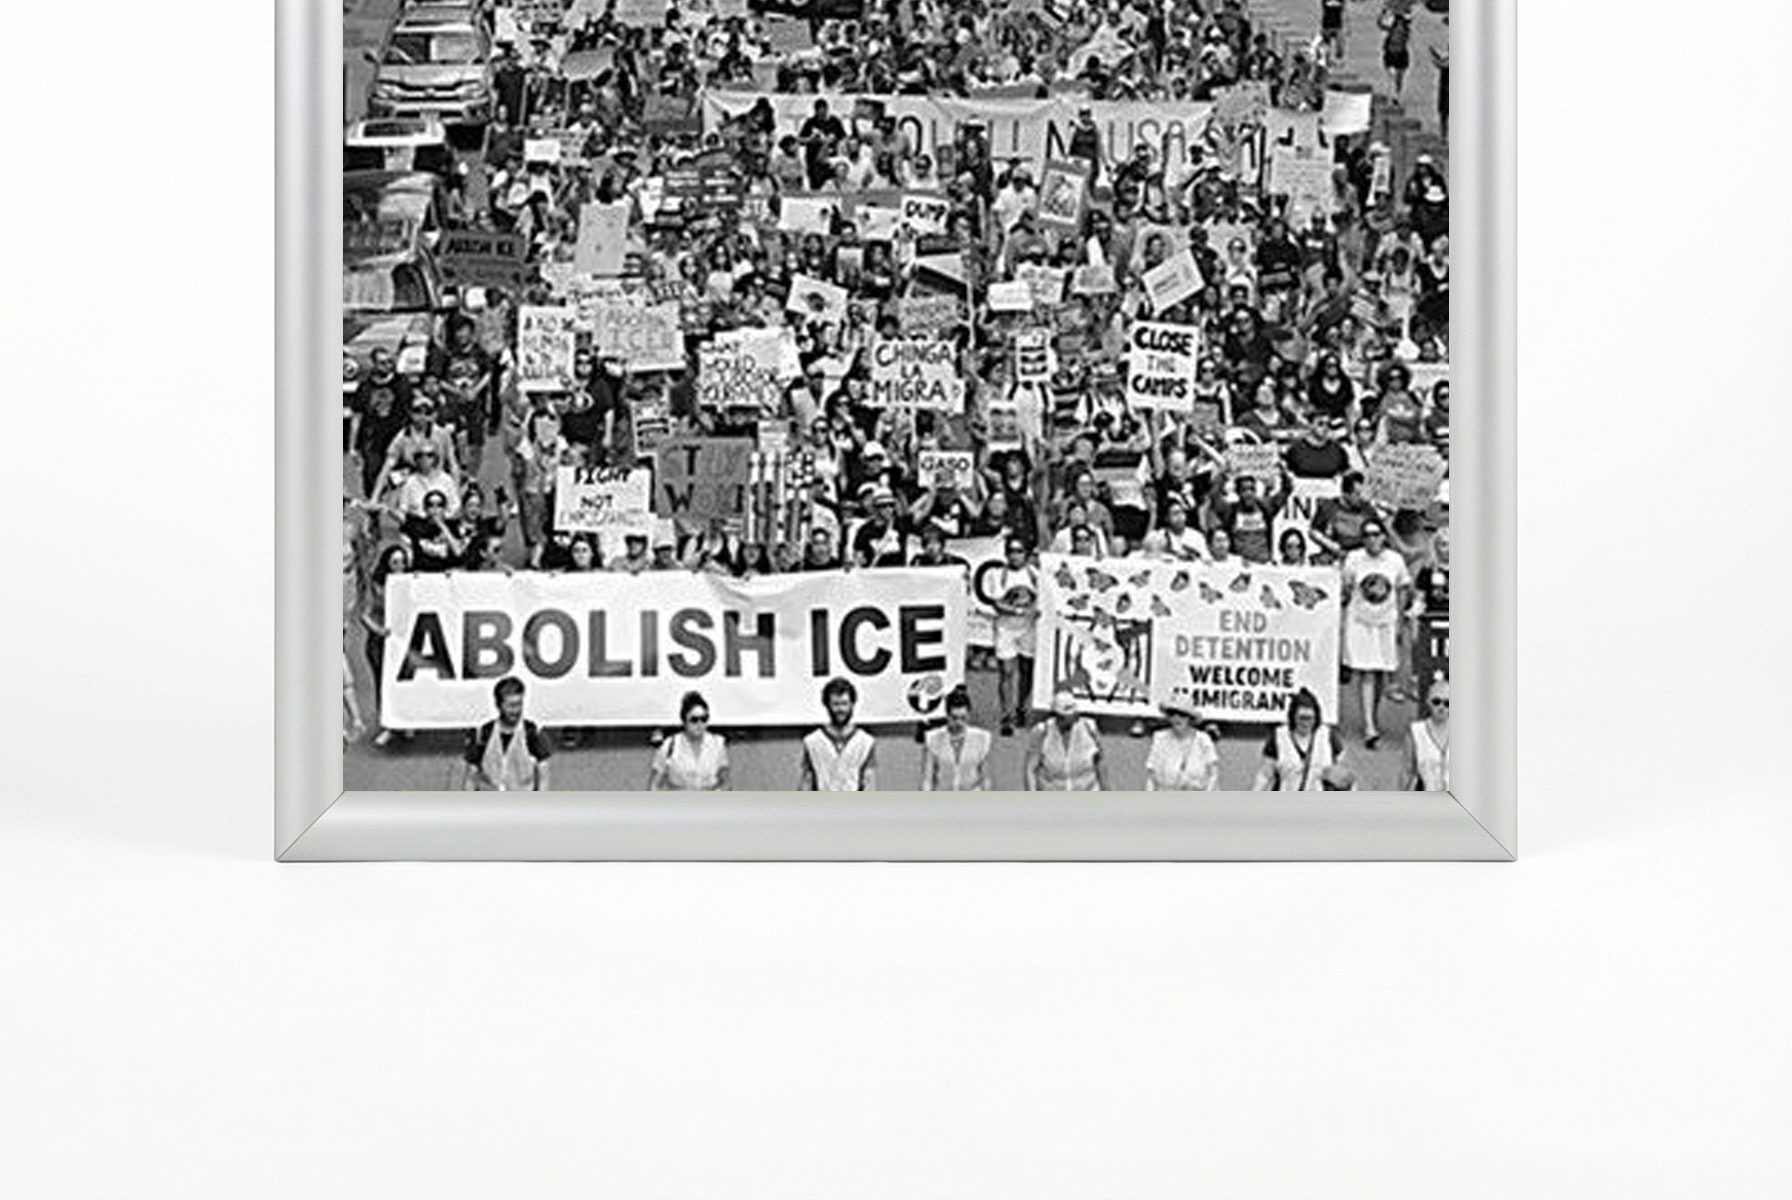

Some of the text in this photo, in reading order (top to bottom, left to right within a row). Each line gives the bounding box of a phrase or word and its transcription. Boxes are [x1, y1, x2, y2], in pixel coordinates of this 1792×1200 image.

[1132, 326, 1194, 357] CLOSE
[1131, 374, 1189, 399] CAMPS
[1219, 609, 1268, 634] END
[396, 604, 948, 681] ABOLISH ICE
[1174, 634, 1311, 662] DETENTION
[1188, 664, 1295, 688] WELCOME
